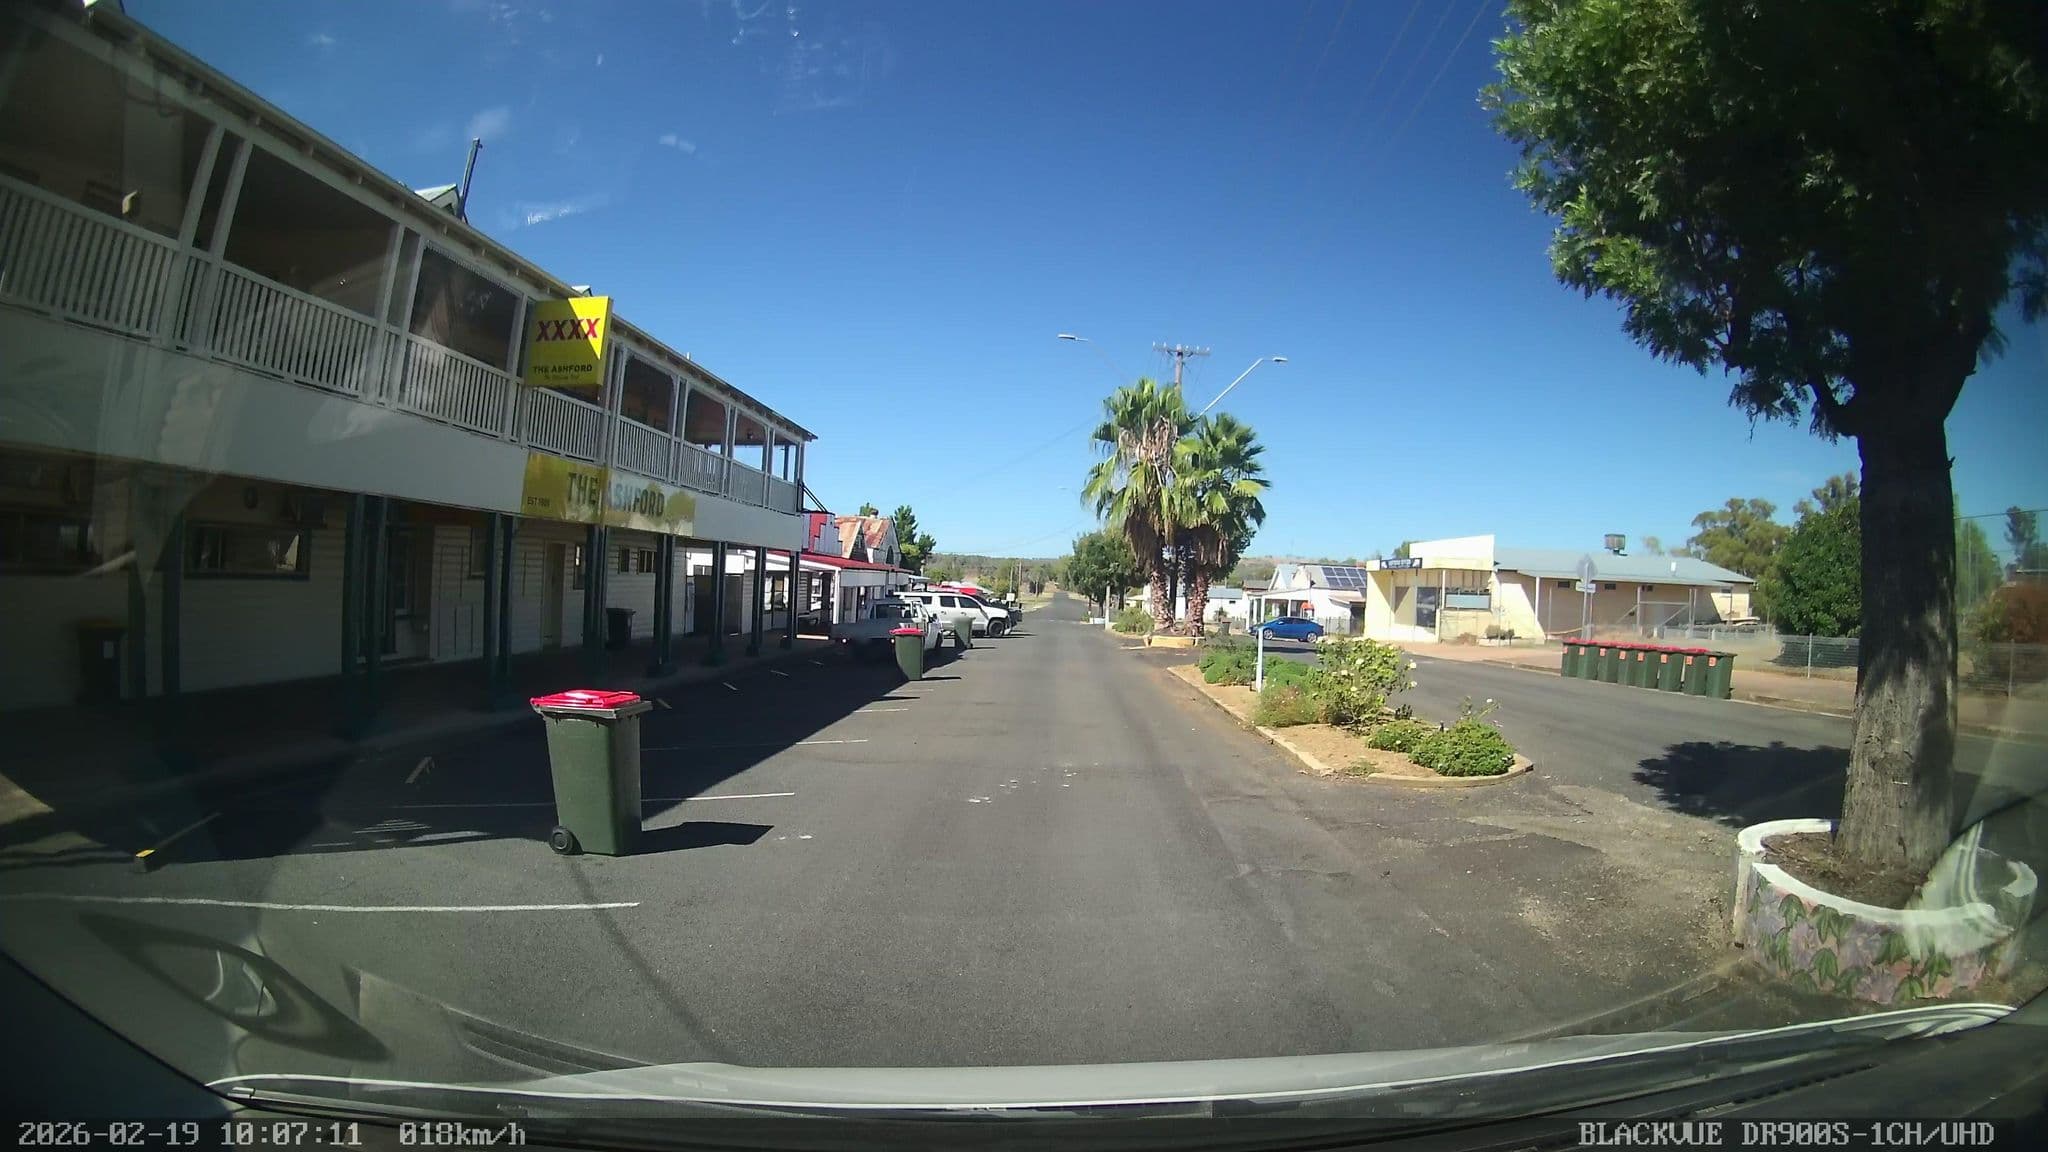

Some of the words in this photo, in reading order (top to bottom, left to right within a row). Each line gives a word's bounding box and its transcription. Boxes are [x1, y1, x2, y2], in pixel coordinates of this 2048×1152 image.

[536, 318, 600, 341] XXXX
[533, 366, 548, 374] THE
[551, 364, 593, 373] ASHFORD
[567, 472, 600, 506] THE
[604, 479, 665, 517] ASHFORD
